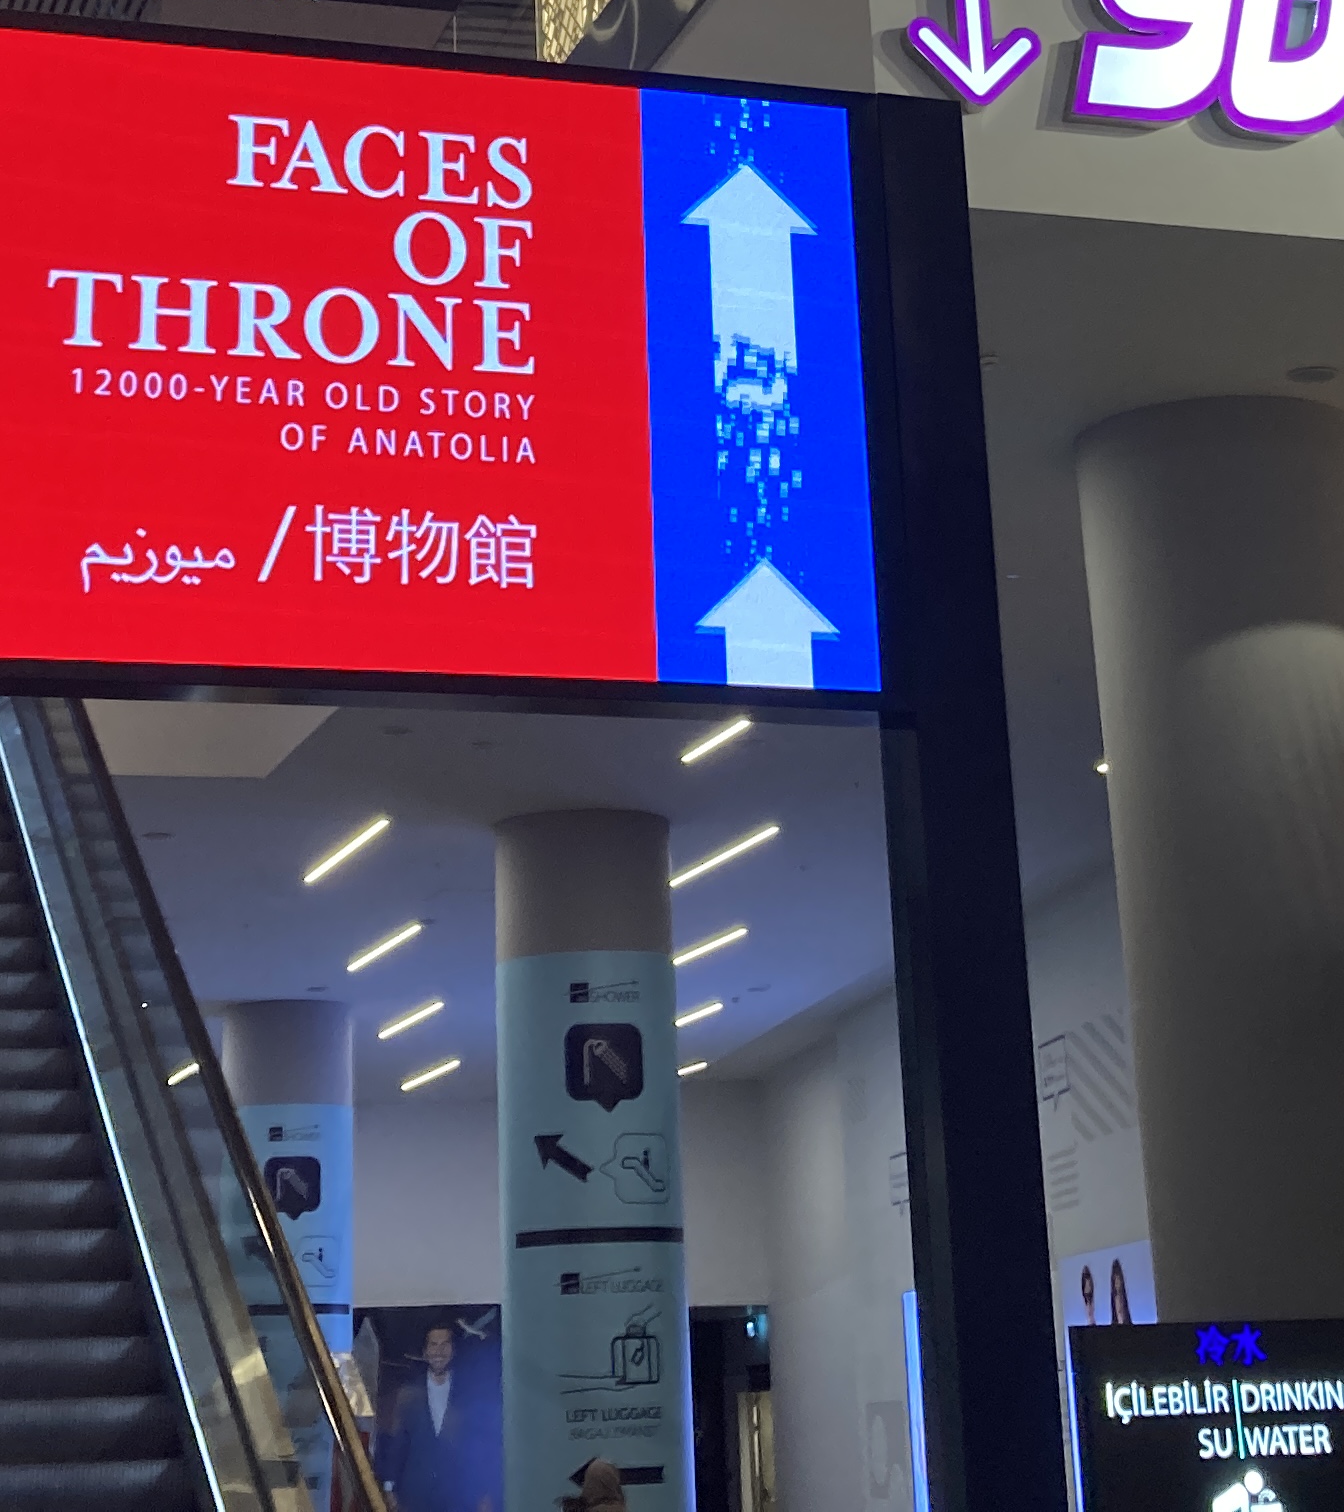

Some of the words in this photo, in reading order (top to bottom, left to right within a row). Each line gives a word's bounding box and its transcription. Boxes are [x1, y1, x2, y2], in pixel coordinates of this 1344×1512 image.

[226, 114, 534, 210] FACES
[393, 210, 535, 290] OF
[47, 269, 536, 376] THRONE
[71, 367, 306, 407] 12000-YEAR
[325, 381, 400, 414] OLD
[419, 388, 536, 421] STORY
[280, 423, 328, 452] OF
[347, 427, 537, 465] ANATOLIA
[304, 504, 538, 589] 博物館
[1194, 1323, 1268, 1366] 冷水
[1198, 1426, 1234, 1459] SU
[1243, 1423, 1334, 1456] WATER
